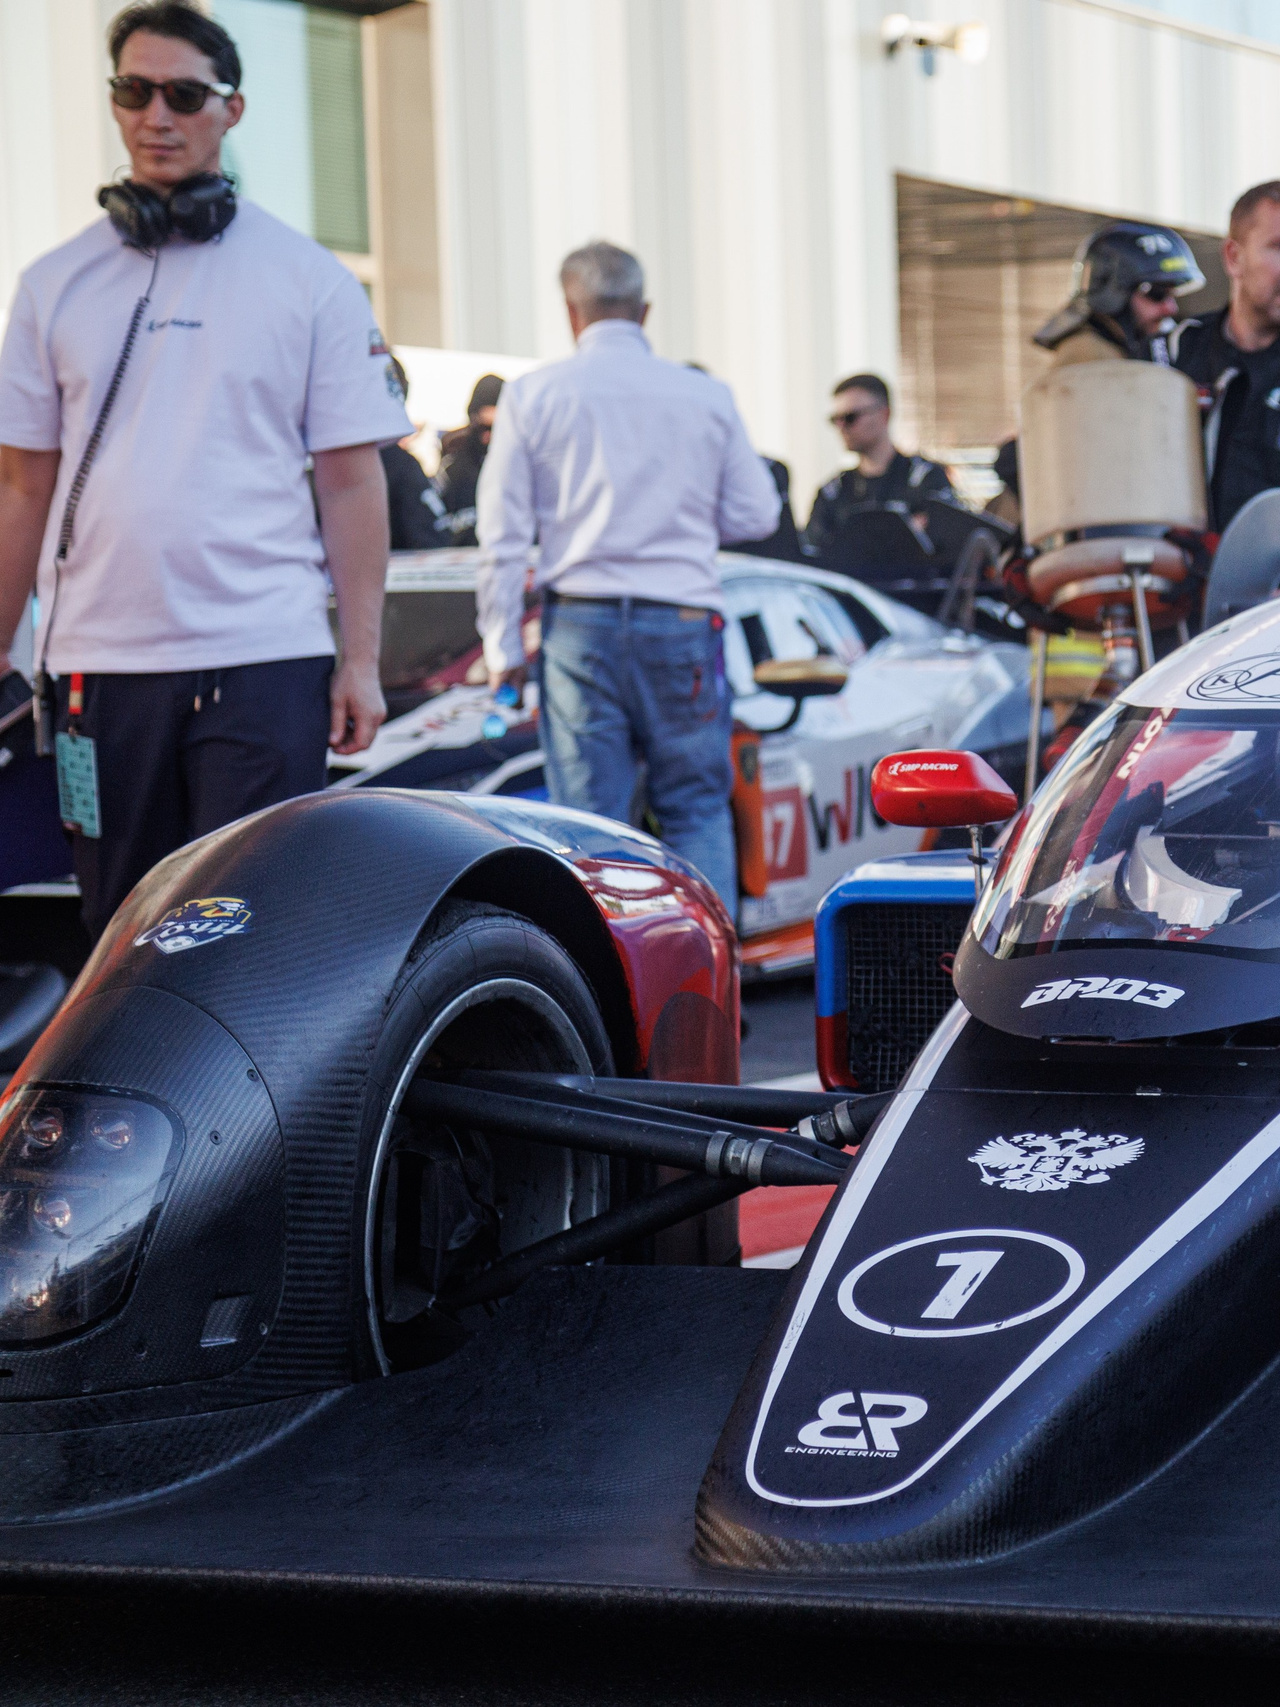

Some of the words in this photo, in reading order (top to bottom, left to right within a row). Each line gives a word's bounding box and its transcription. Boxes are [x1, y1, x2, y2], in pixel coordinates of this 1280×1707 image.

[899, 763, 921, 773] SMP
[920, 762, 959, 772] RACING
[920, 1250, 1005, 1320] 1
[797, 1391, 928, 1451] BR
[784, 1446, 898, 1459] ENGINEERING
